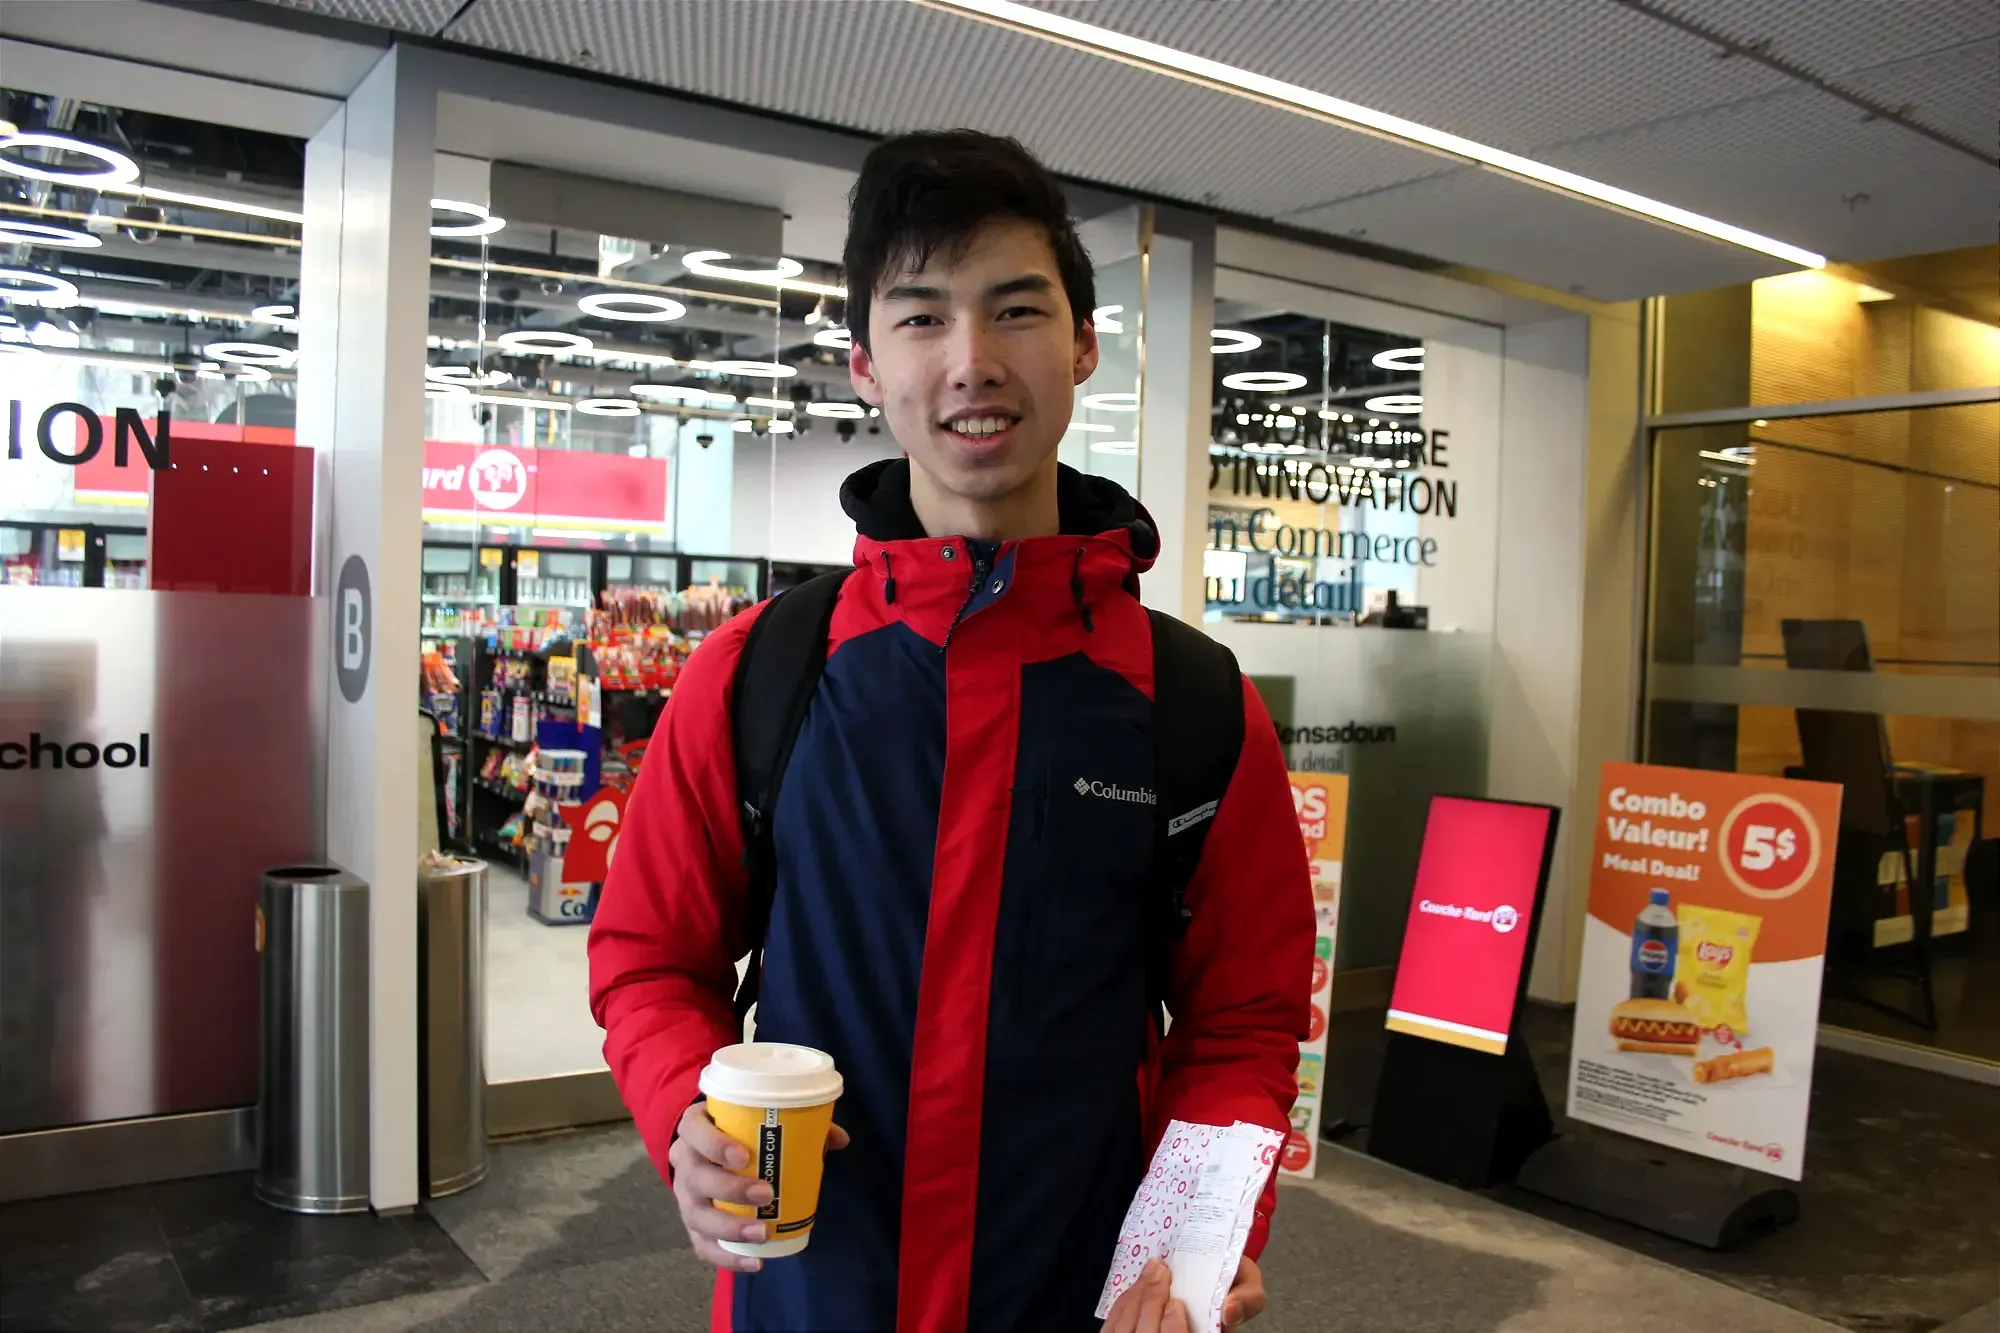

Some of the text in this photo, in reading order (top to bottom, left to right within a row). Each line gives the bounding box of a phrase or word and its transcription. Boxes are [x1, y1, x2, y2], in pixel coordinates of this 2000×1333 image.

[1249, 508, 1438, 566] Commerce
[343, 588, 363, 670] B
[1091, 781, 1157, 805] Columbia
[1608, 787, 1706, 820] Combo
[1606, 816, 1709, 852] Valeur!
[1740, 824, 1796, 871] 5$
[1603, 852, 1701, 881] Meal Deal!
[766, 1131, 776, 1151] CUP
